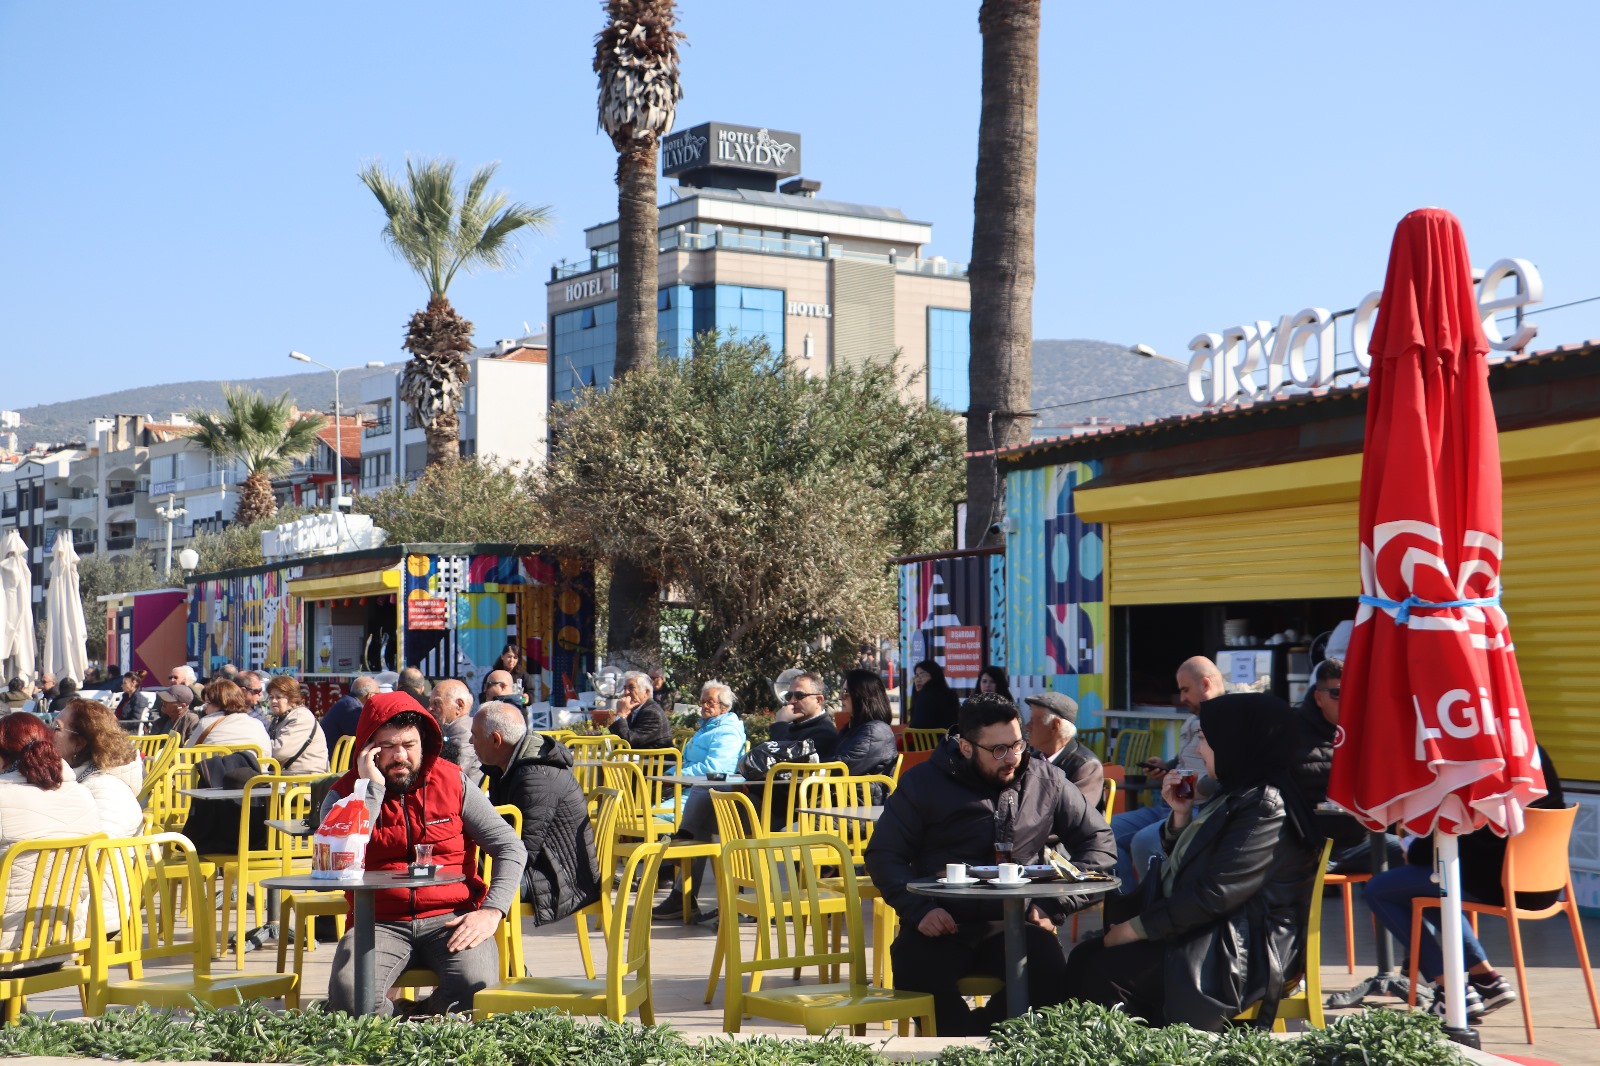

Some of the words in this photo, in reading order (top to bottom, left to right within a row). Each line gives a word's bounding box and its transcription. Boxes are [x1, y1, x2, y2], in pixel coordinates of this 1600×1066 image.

[718, 130, 755, 144] HOTEL
[566, 278, 603, 303] HOTEL
[787, 301, 832, 318] HOTEL
